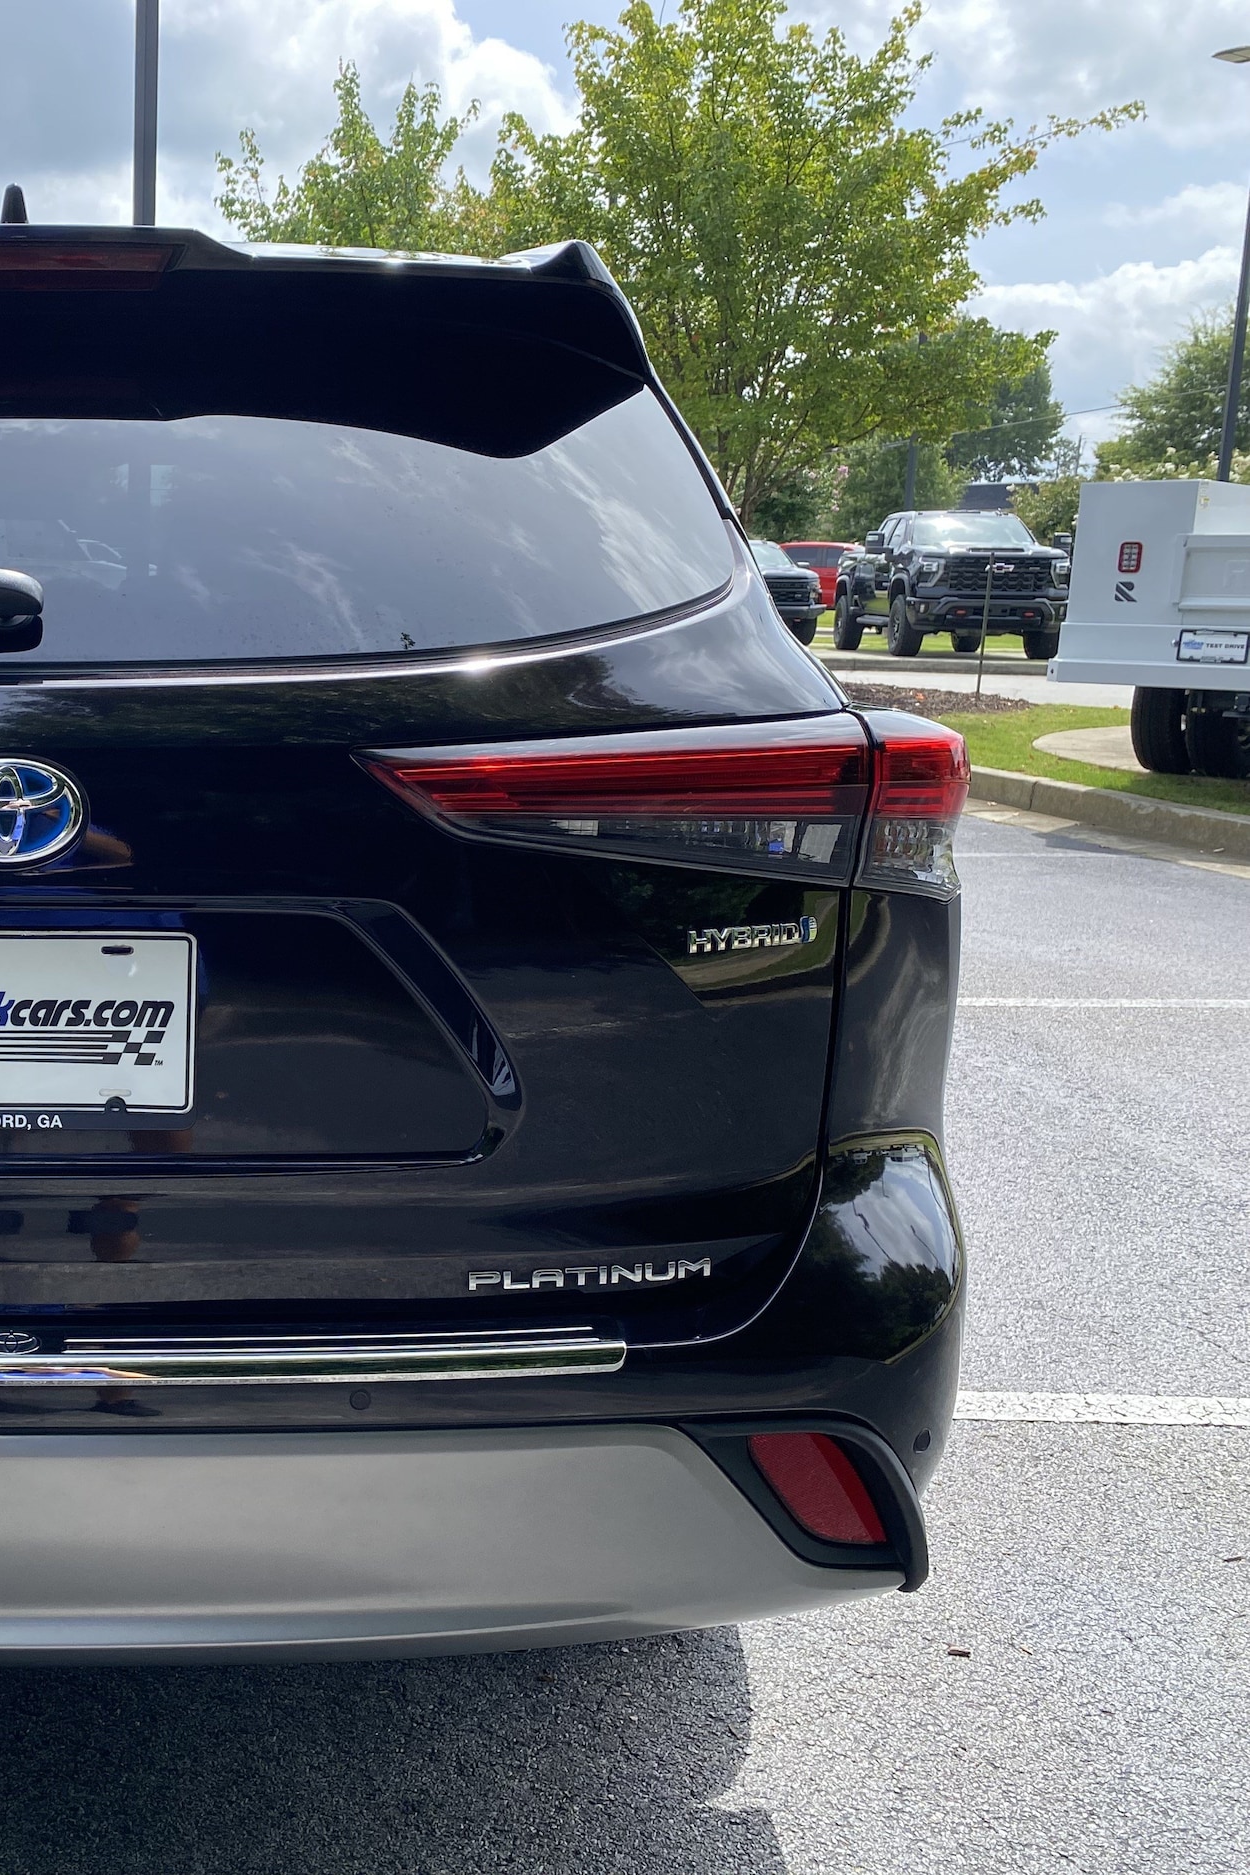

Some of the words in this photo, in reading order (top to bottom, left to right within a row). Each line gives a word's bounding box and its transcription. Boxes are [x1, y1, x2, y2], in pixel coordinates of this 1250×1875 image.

[688, 922, 800, 954] HYBRID
[37, 1114, 63, 1129] GA
[468, 1257, 711, 1291] PLATINUM
